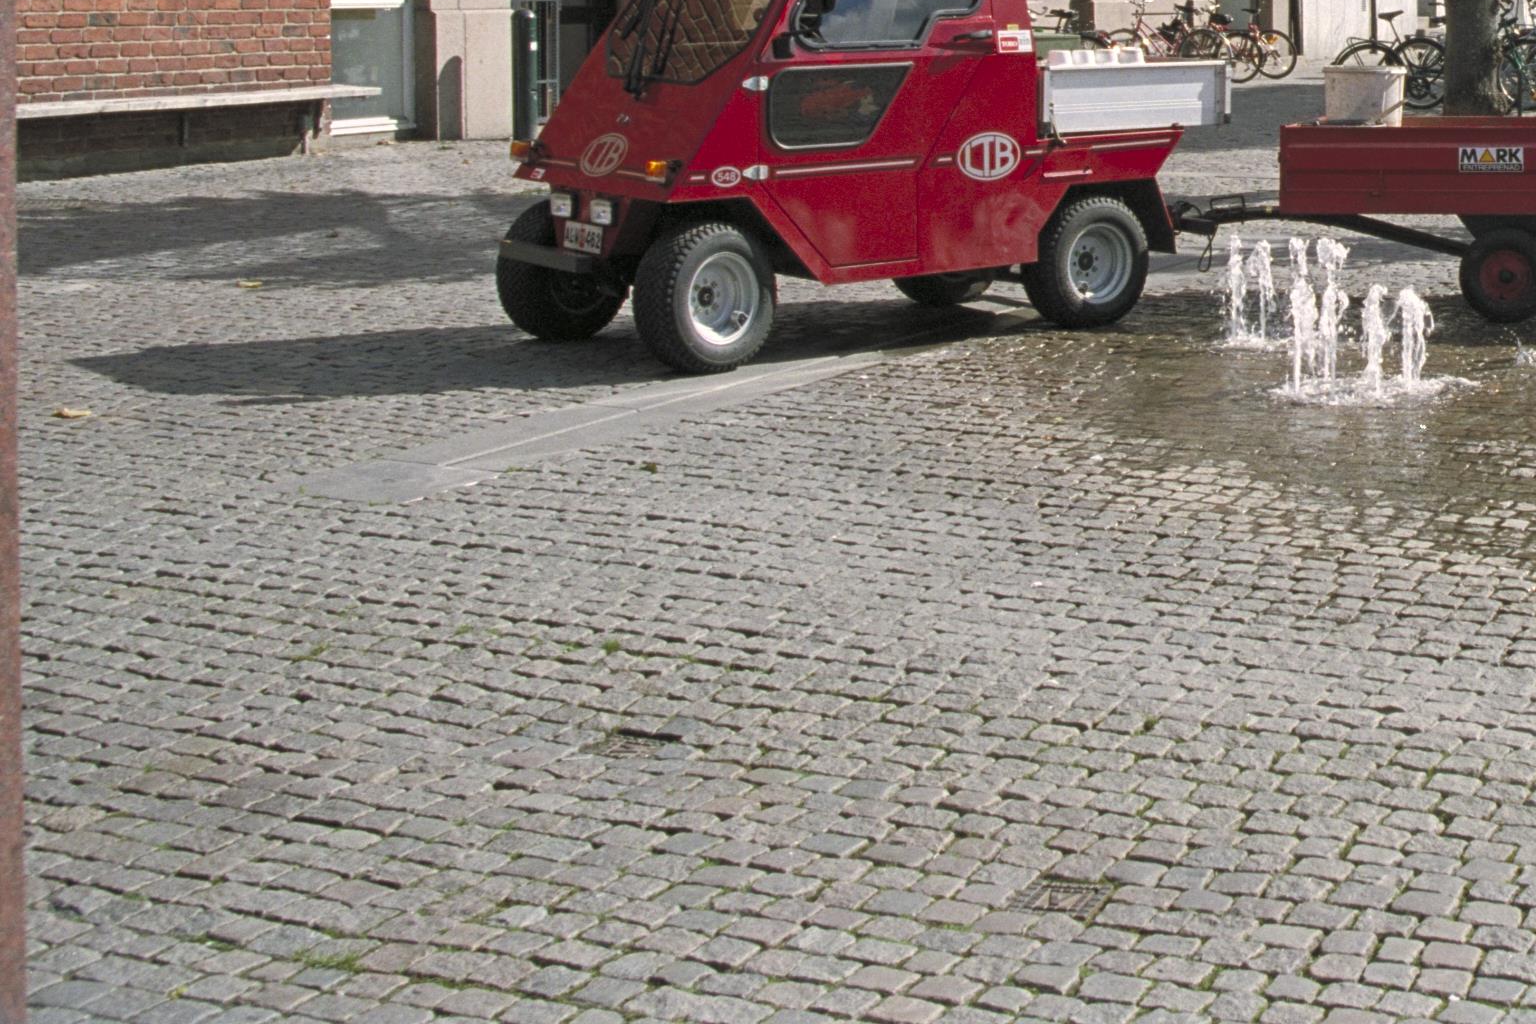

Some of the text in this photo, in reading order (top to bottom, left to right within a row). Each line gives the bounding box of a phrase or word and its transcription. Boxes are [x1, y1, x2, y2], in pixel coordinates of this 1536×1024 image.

[964, 135, 1015, 177] LTB
[1461, 148, 1521, 163] MARK
[716, 171, 737, 182] 548
